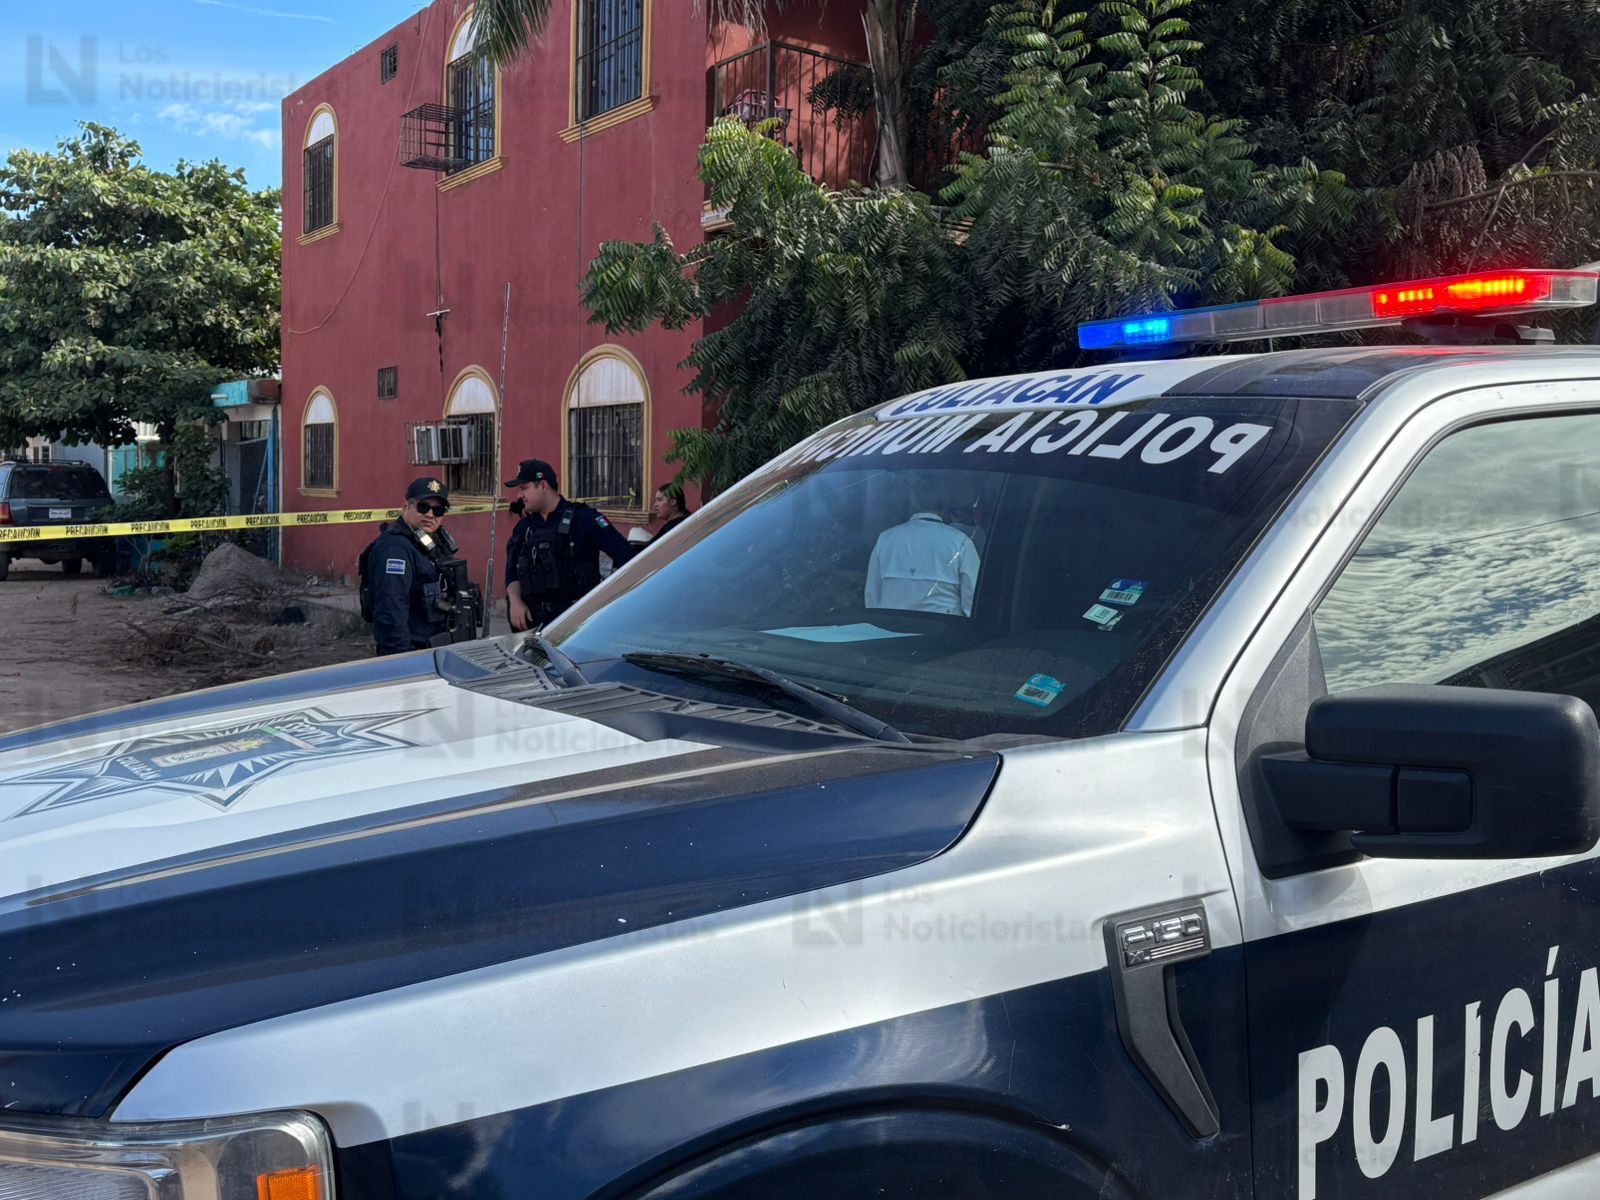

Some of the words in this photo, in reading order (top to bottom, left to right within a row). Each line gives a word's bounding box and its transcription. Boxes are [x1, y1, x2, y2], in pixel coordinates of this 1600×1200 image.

[892, 369, 1144, 416] CULIACÁN
[0, 527, 41, 539] RECAUCION
[1297, 945, 1600, 1200] POLICÍA
